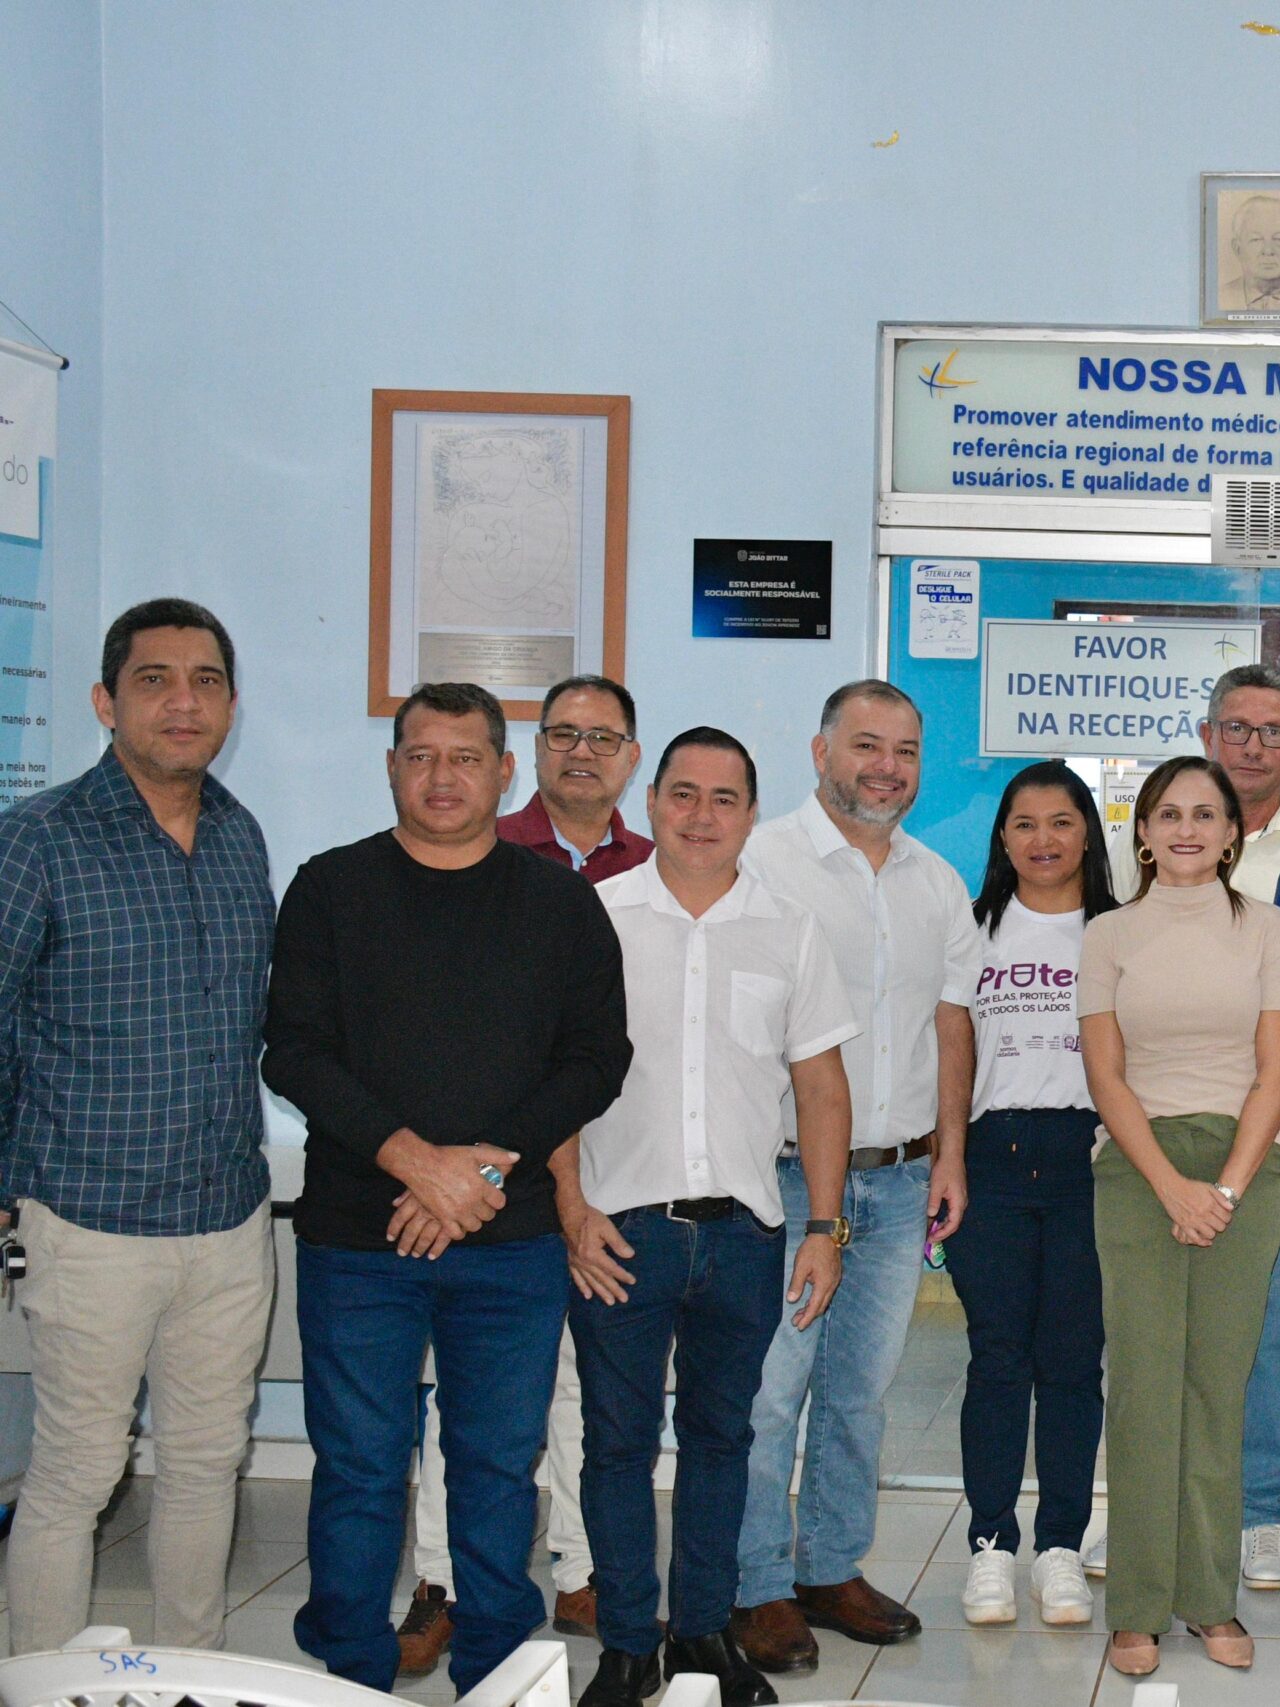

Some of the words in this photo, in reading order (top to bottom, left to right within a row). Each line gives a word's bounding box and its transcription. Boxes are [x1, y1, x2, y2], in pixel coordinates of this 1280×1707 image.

[1078, 356, 1247, 395] NOSSA
[953, 404, 1058, 428] Promover
[1066, 409, 1204, 432] atendimento
[953, 437, 1067, 460] referência
[1075, 441, 1165, 466] regional
[1172, 444, 1199, 464] de
[1207, 444, 1273, 466] forma
[952, 466, 1054, 489] usuários.
[1061, 469, 1075, 489] E
[1083, 471, 1190, 495] qualidade
[924, 570, 951, 578] STERILE
[751, 581, 789, 589] EMPRESA
[791, 580, 796, 589] É
[704, 590, 761, 598] SOCIALMENTE
[762, 590, 820, 599] RESPONSÁVEL
[1074, 635, 1168, 661] FAVOR
[2, 666, 47, 678] necessárias
[1007, 672, 1216, 702] IDENTIFIQUE-S
[1, 715, 31, 726] manejo
[36, 716, 47, 726] do
[1017, 711, 1059, 736] NA
[6, 761, 26, 772] meia
[28, 762, 46, 773] hora
[8, 777, 32, 788] bebês
[34, 780, 46, 788] em
[1020, 991, 1072, 1002] PROTEÇÃO
[978, 1010, 988, 1020] DE
[988, 1004, 1020, 1016] TODOS
[1022, 1004, 1036, 1013] OS
[99, 1651, 157, 1674] SAS
